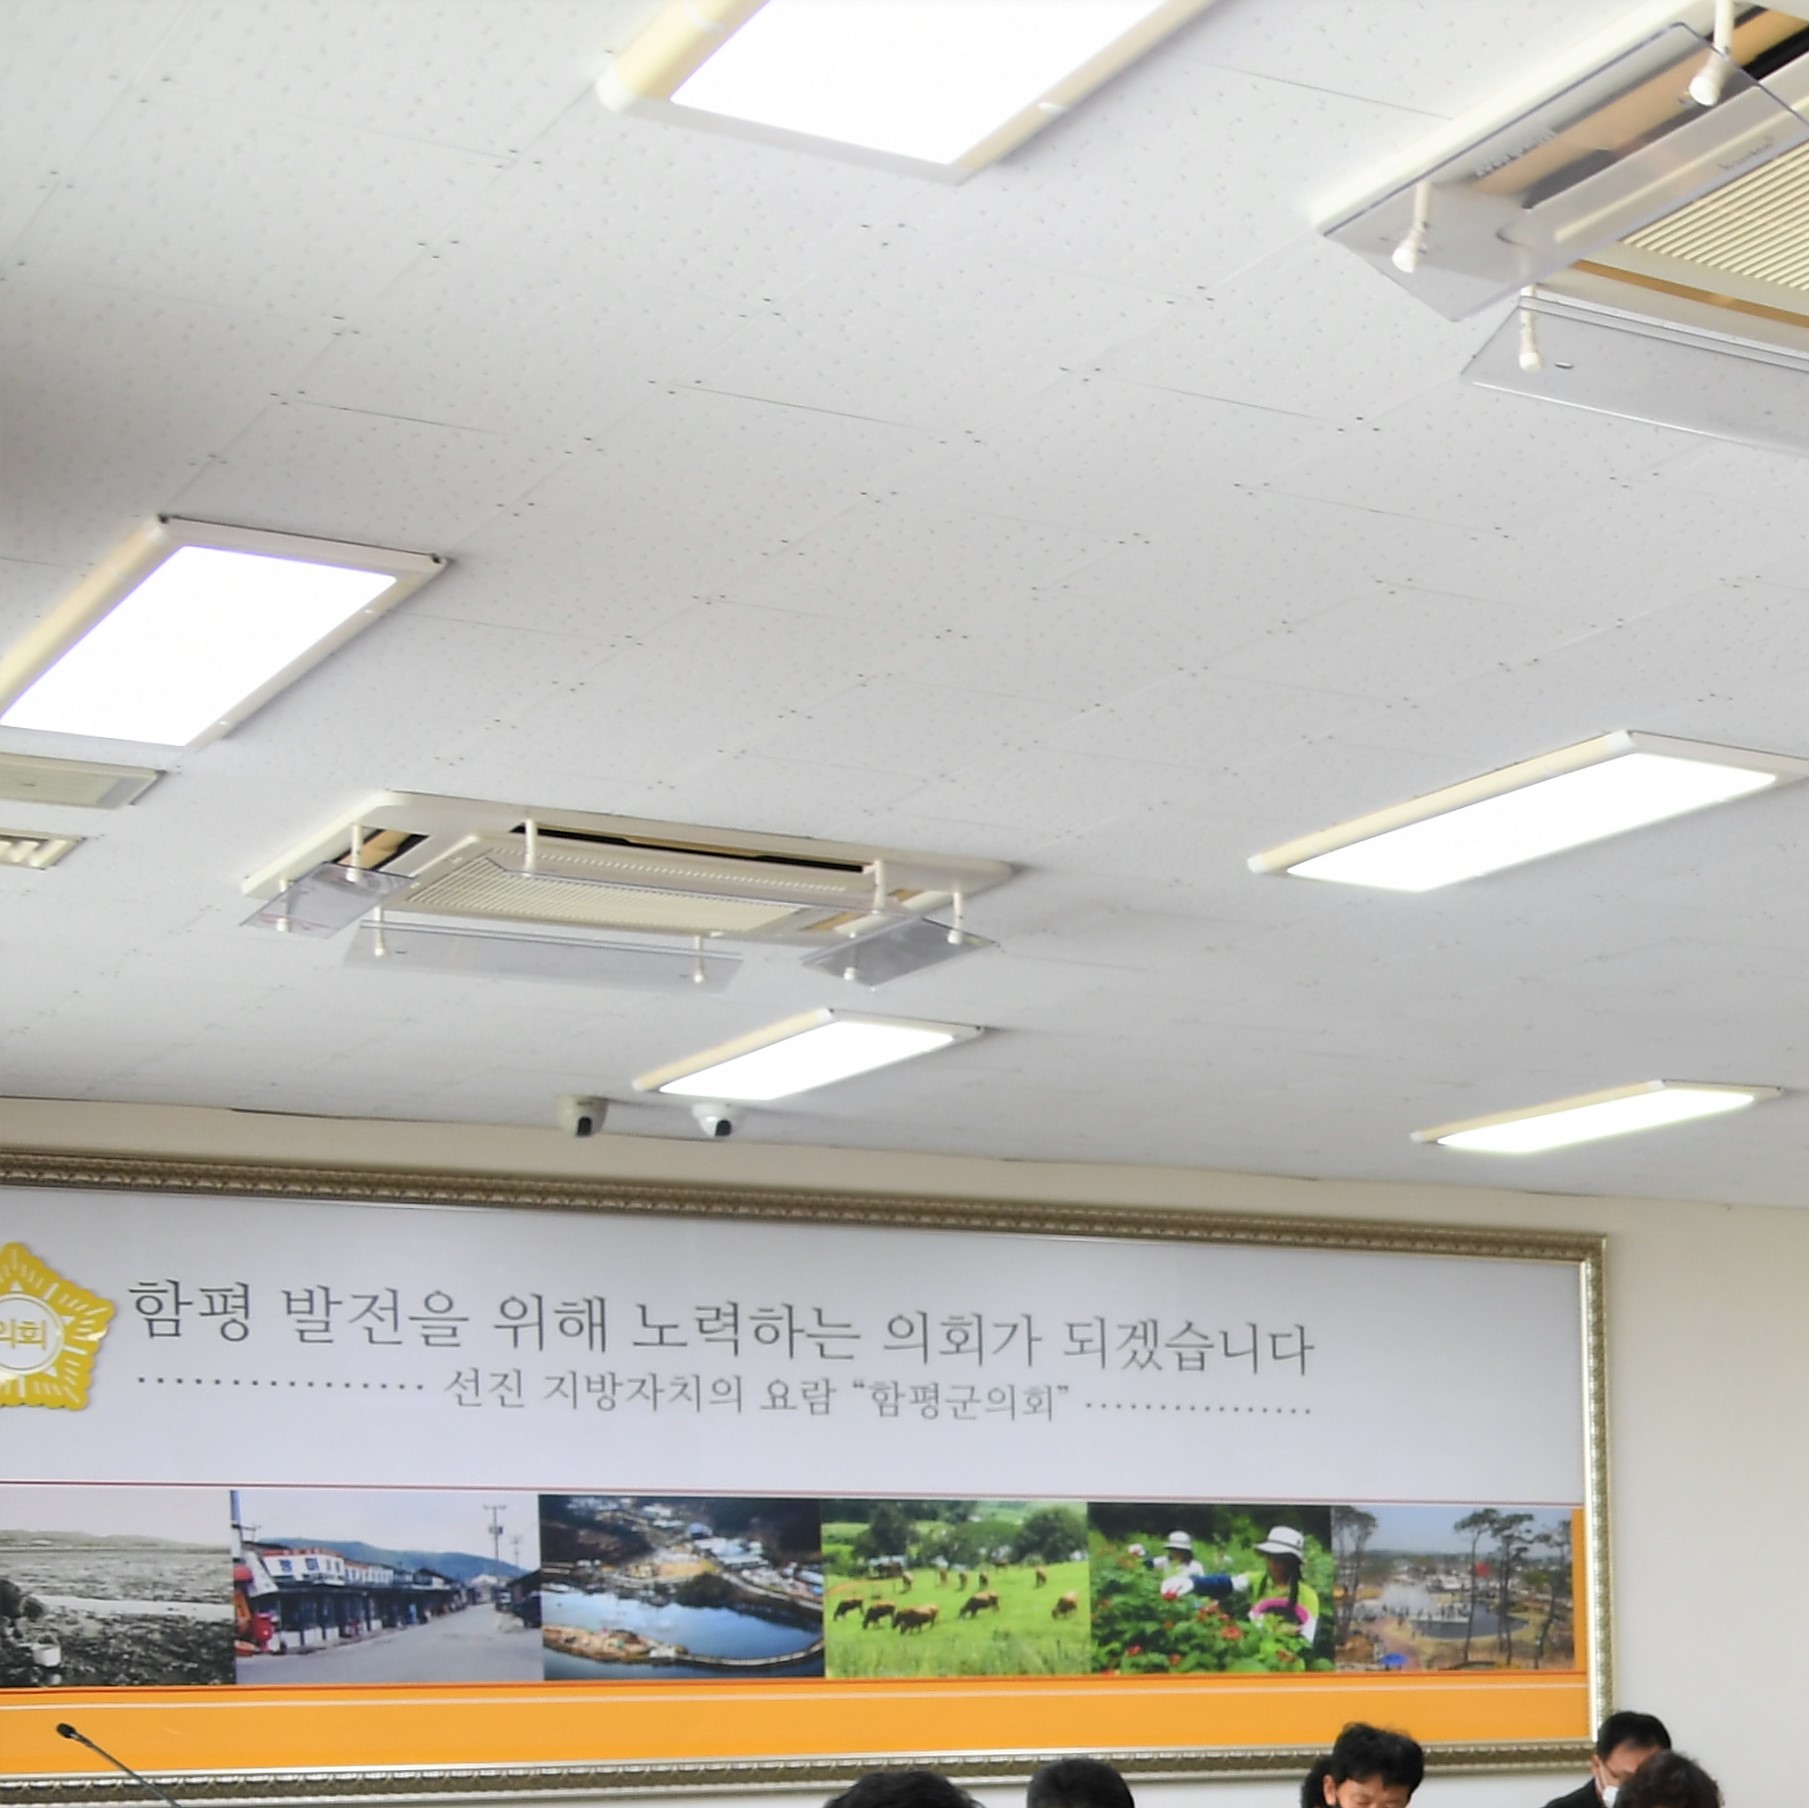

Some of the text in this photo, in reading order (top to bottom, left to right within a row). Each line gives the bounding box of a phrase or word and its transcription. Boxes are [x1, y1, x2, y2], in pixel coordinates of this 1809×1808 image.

[128, 1278, 1316, 1377] 함평 발전을 위해 노력하는 의회가 되겠습니다
[445, 1367, 525, 1409] 선진
[545, 1370, 743, 1415] 지방자치의
[761, 1377, 837, 1416] 요람
